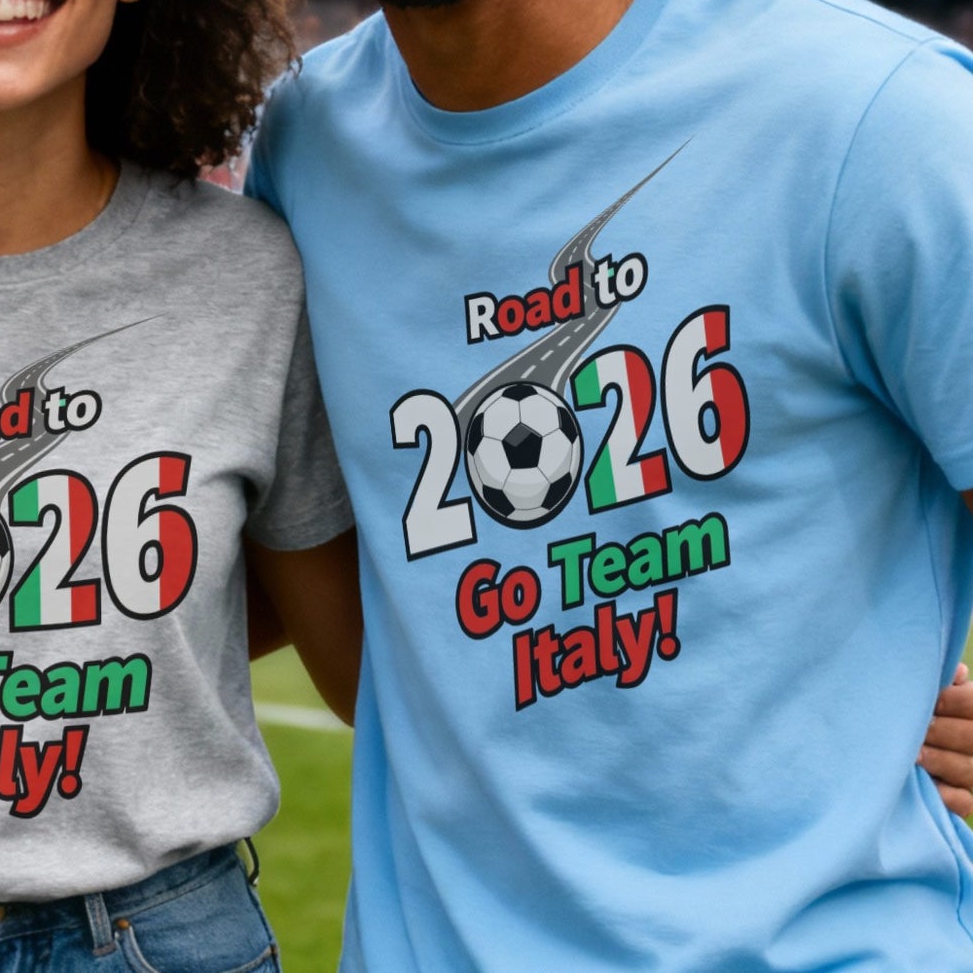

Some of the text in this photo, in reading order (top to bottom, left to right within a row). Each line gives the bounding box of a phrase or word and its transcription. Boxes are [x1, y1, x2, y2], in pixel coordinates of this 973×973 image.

[464, 252, 648, 345] Road to
[42, 387, 102, 435] to
[456, 512, 731, 640] Go Team
[512, 588, 681, 712] Italy!
